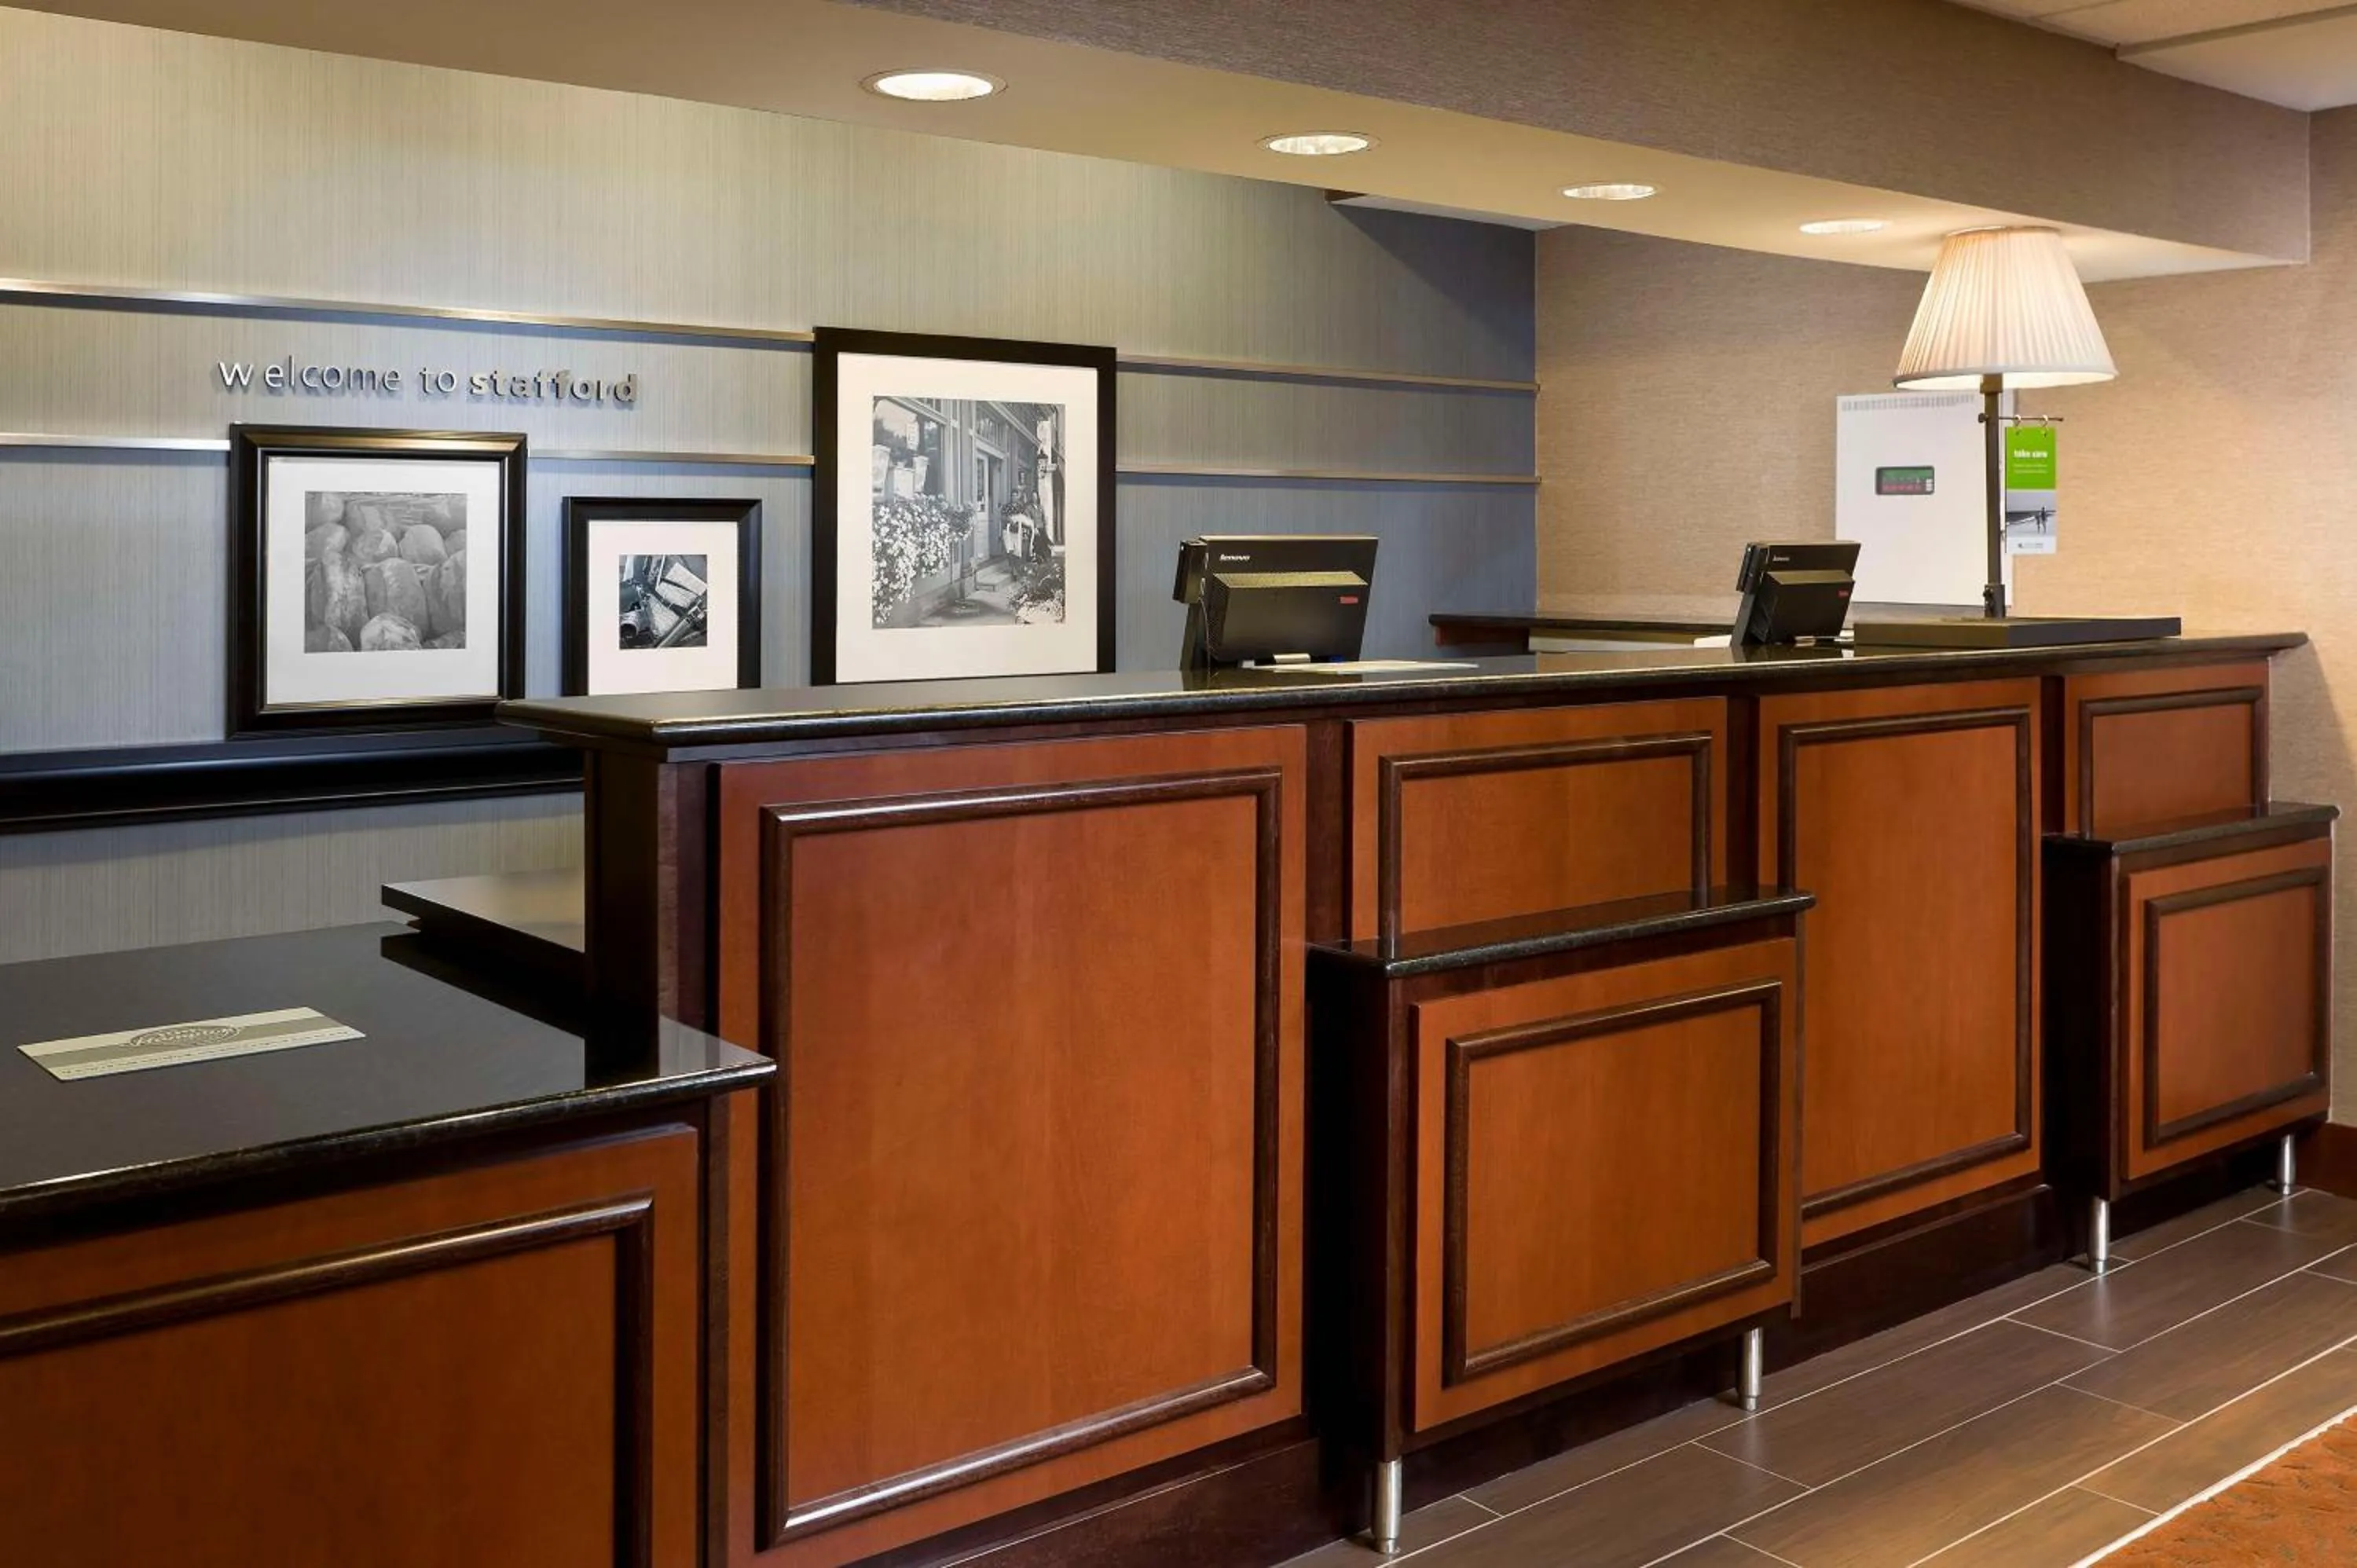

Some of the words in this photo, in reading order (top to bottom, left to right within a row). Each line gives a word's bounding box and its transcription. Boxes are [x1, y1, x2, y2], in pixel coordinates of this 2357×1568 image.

[218, 355, 401, 390] welcome
[420, 367, 457, 394] to
[470, 368, 638, 403] stafford
